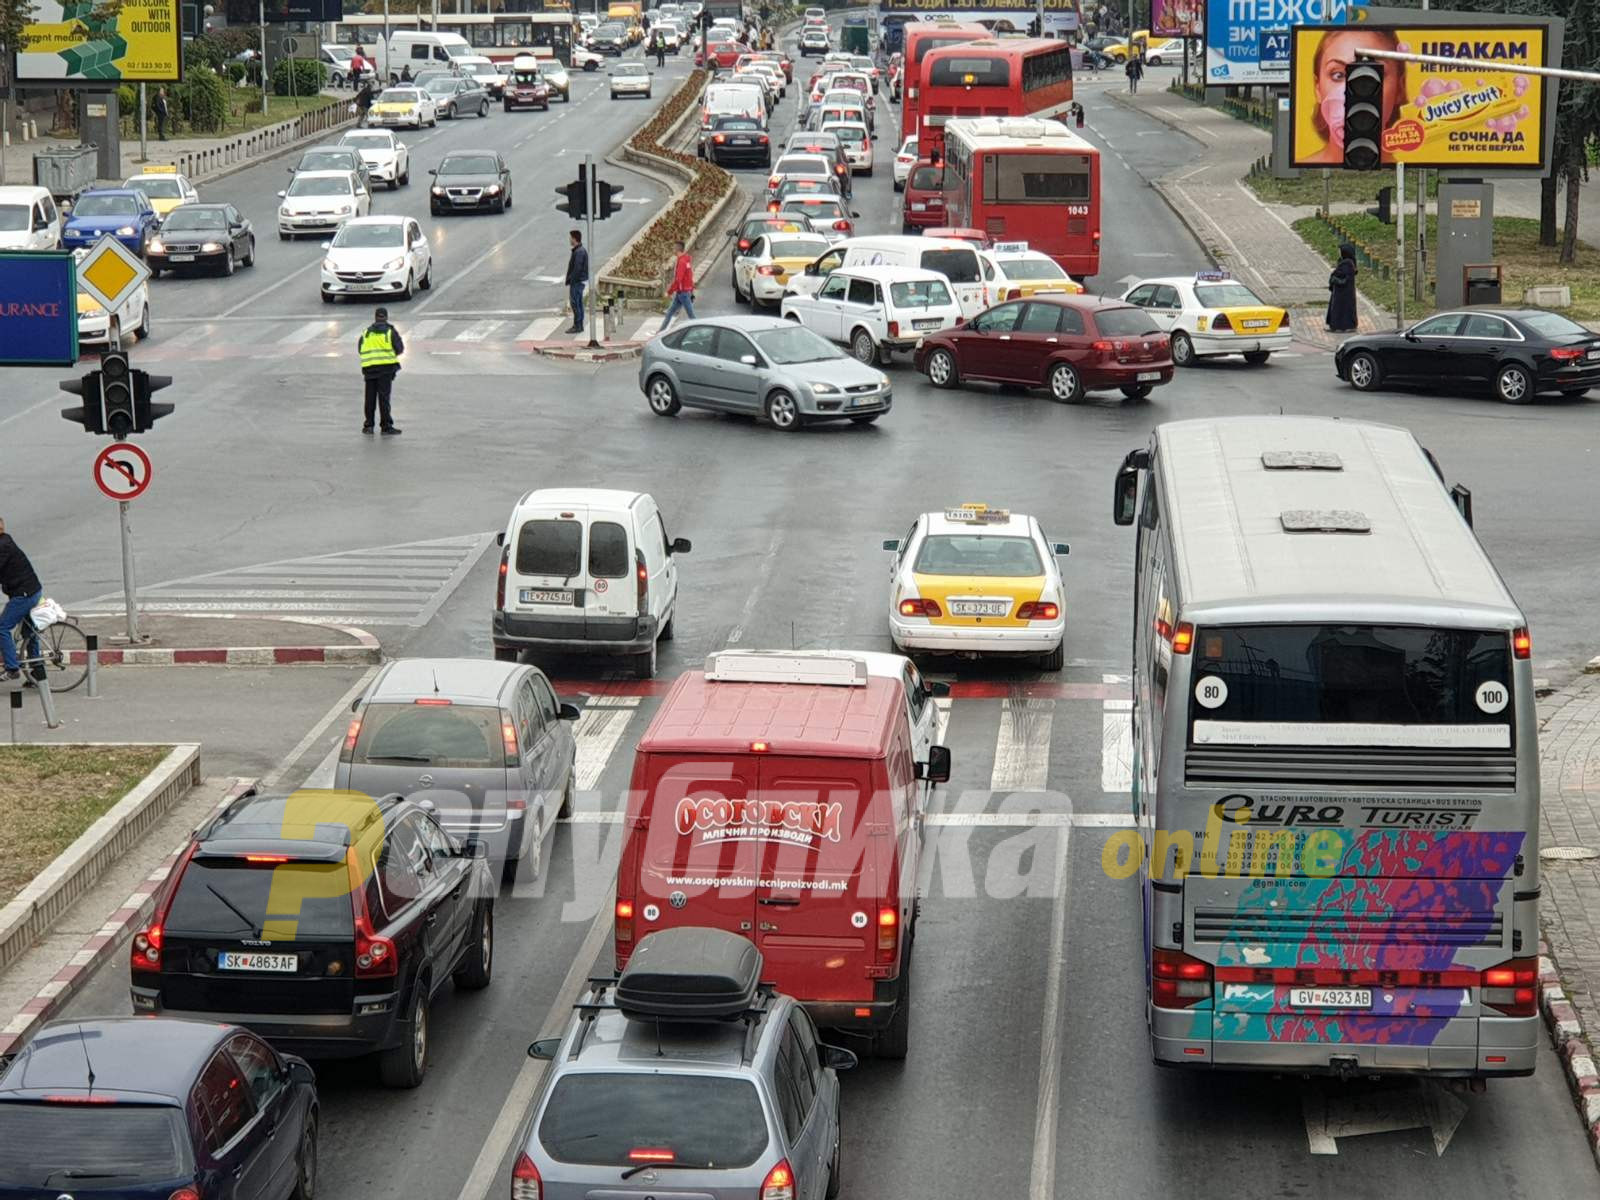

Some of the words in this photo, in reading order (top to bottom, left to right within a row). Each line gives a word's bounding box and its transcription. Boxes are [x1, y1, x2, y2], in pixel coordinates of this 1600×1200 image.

[148, 9, 170, 20] WITH
[131, 21, 171, 33] OUTDOOR
[54, 34, 83, 42] media
[1425, 101, 1462, 122] Juicy
[1463, 86, 1499, 108] Fruit
[1450, 131, 1499, 142] СОЧНА
[1502, 131, 1524, 144] ДА
[1068, 206, 1088, 215] 1043
[1204, 686, 1219, 699] 80
[1482, 690, 1503, 703] 100
[675, 797, 842, 842] ОСОГОВСКИ
[1361, 807, 1481, 826] TURIST
[702, 827, 748, 841] МЛЕЧНИ
[750, 827, 813, 843] ПРОИЗВОДИ
[1194, 831, 1210, 839] MK
[666, 876, 848, 891] www.osogovskimlecniproizvodi.mk
[1253, 879, 1307, 889] @gmail.com
[227, 955, 240, 968] SK
[248, 955, 279, 969] 4863
[280, 957, 295, 970] AF
[1299, 990, 1315, 1004] GV
[1321, 990, 1351, 1005] 4923
[1354, 991, 1370, 1005] AB
